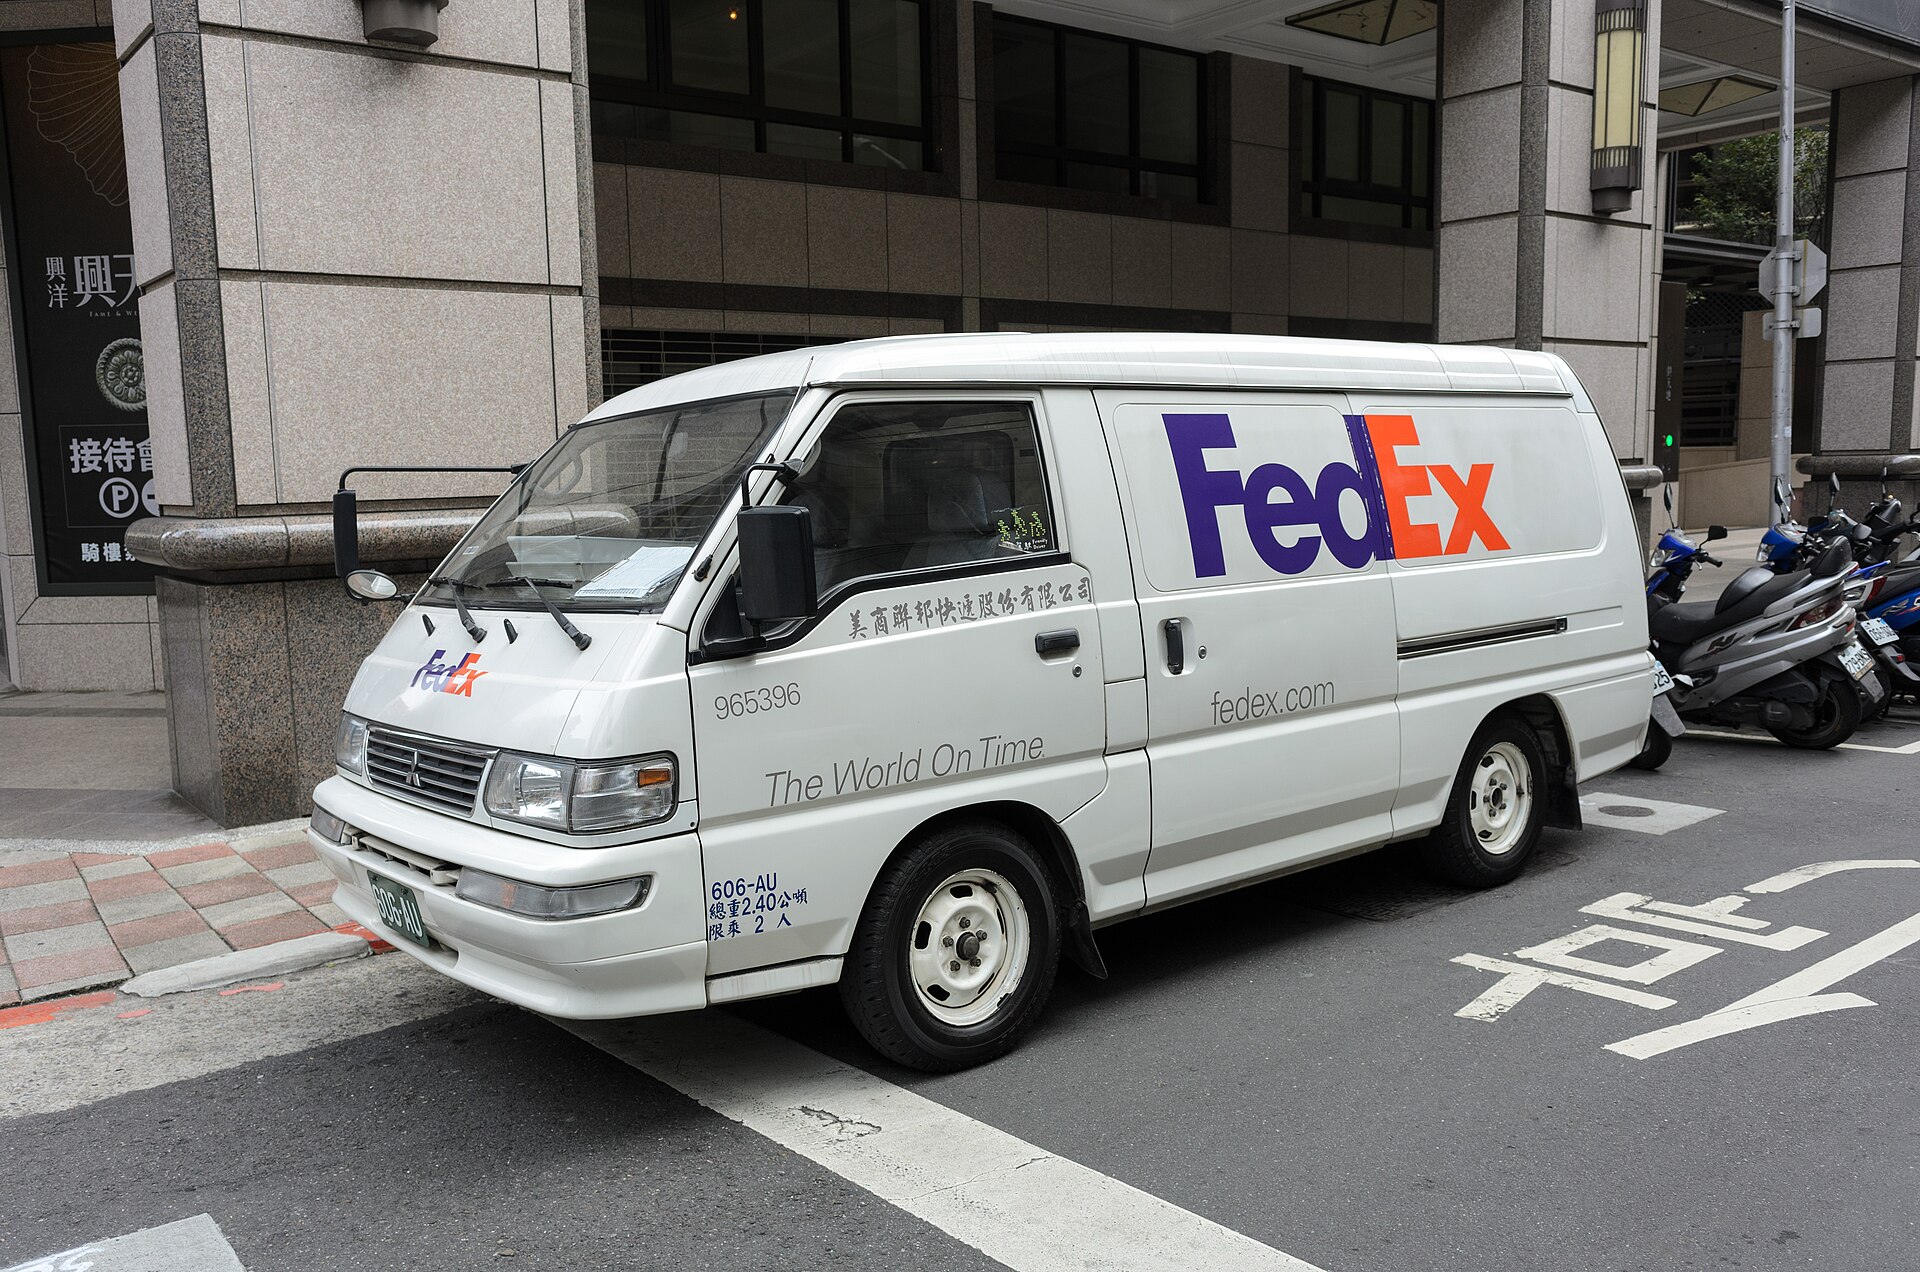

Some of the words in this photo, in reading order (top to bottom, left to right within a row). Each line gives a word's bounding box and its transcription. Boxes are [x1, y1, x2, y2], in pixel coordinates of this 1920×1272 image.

[1161, 413, 1511, 578] FedEx
[849, 577, 1093, 639] 美商聯邦快遞股份有限公司
[409, 649, 489, 697] FedEx
[714, 682, 801, 719] 965396
[1211, 681, 1335, 725] fedex.com
[765, 770, 823, 806] The
[833, 749, 922, 795] World
[932, 743, 971, 777] On
[372, 884, 422, 937] 606-AU
[711, 872, 777, 901] 606-AU
